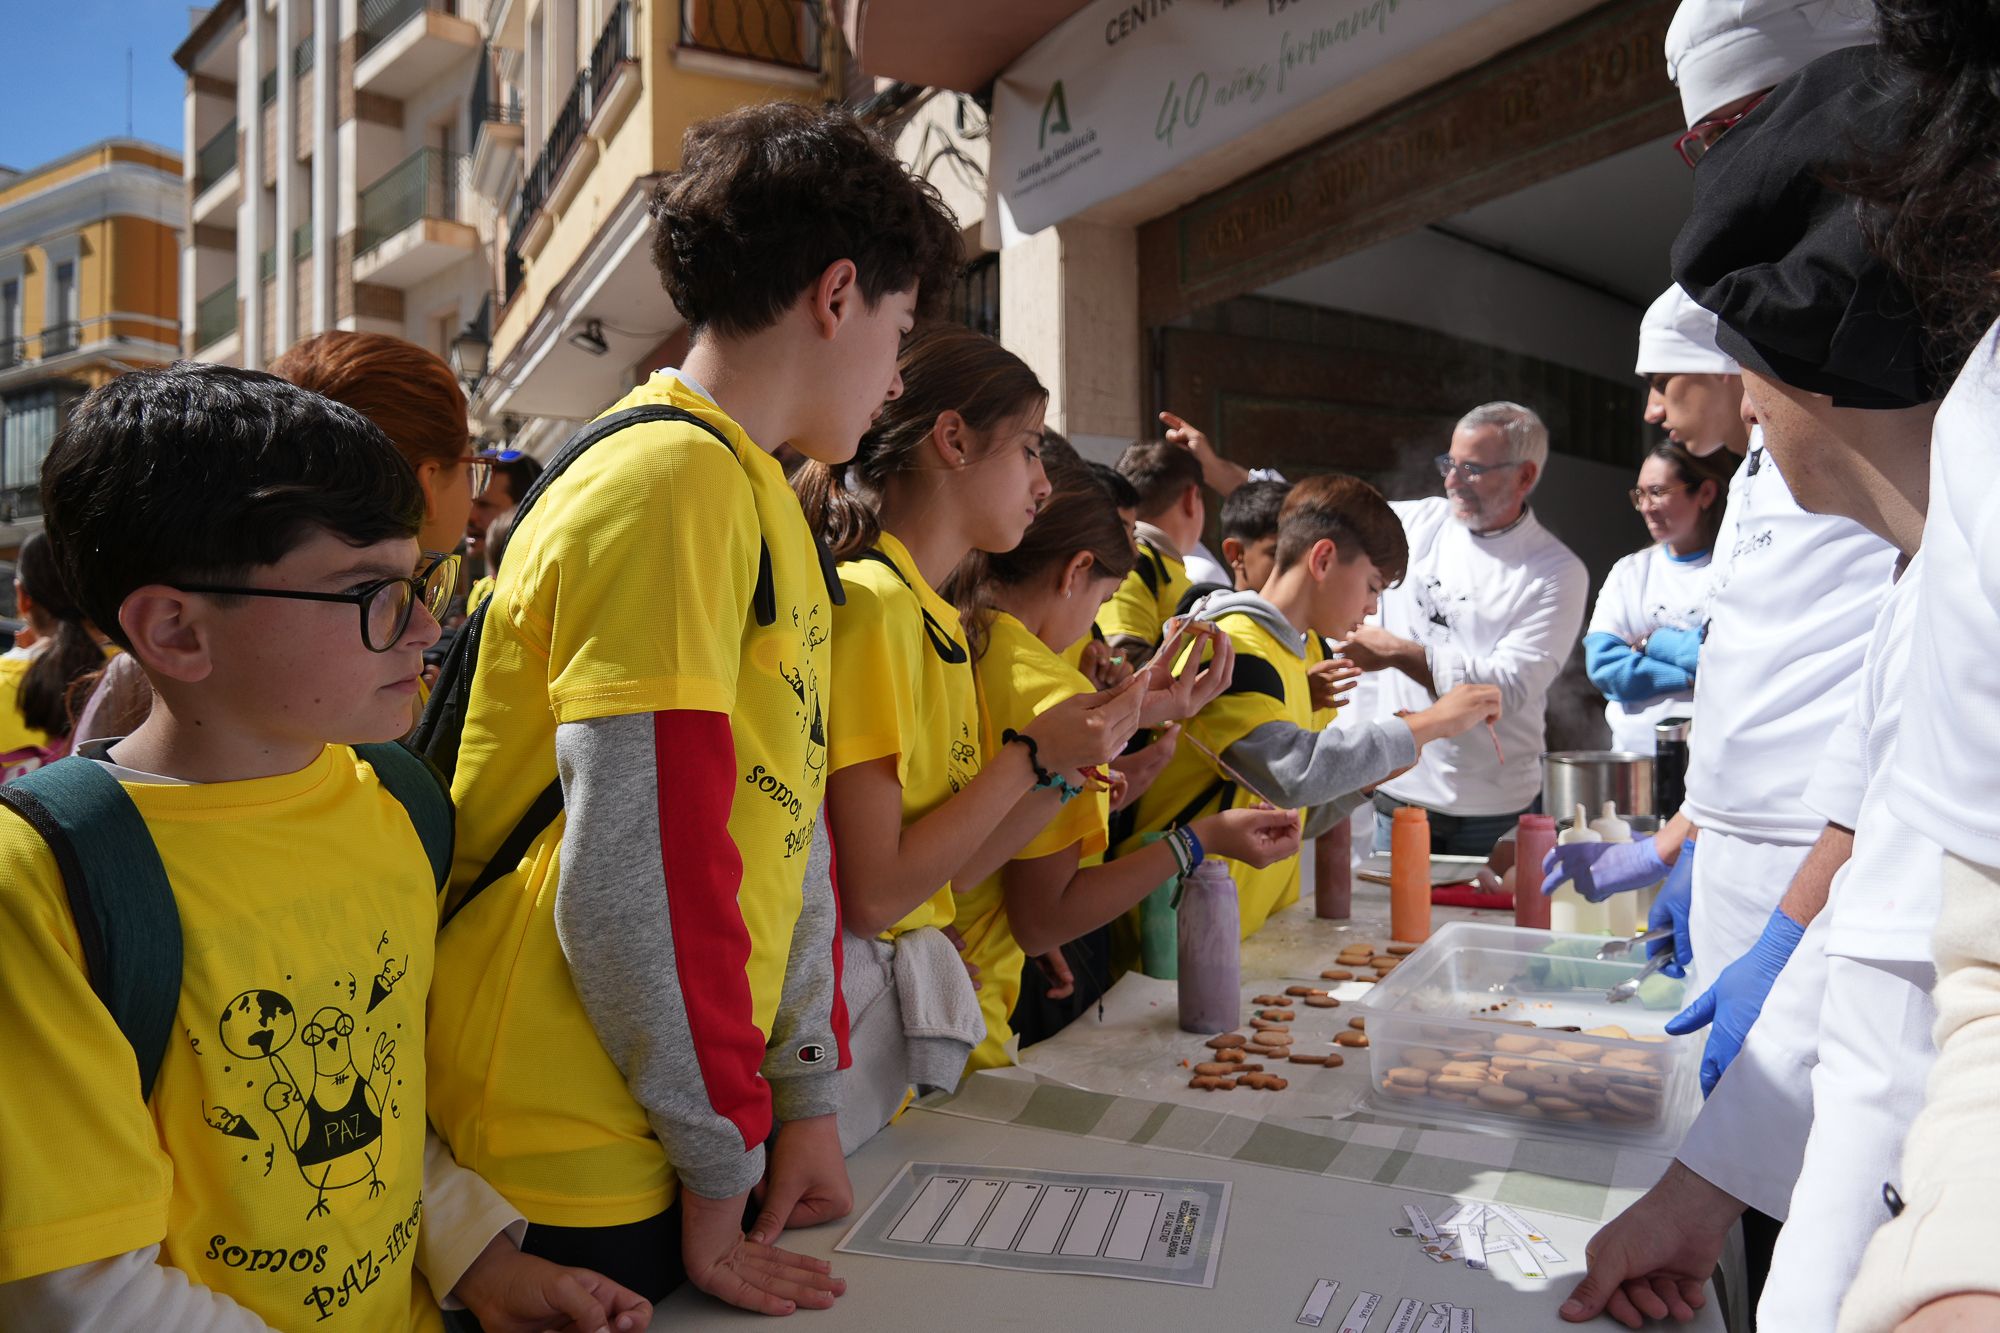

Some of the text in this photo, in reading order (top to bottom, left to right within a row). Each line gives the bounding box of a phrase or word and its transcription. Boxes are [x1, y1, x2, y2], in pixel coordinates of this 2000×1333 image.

[1154, 71, 1210, 149] 40
[1503, 77, 1541, 127] DE
[1578, 27, 1665, 98] FOR
[323, 1113, 367, 1149] PAZ
